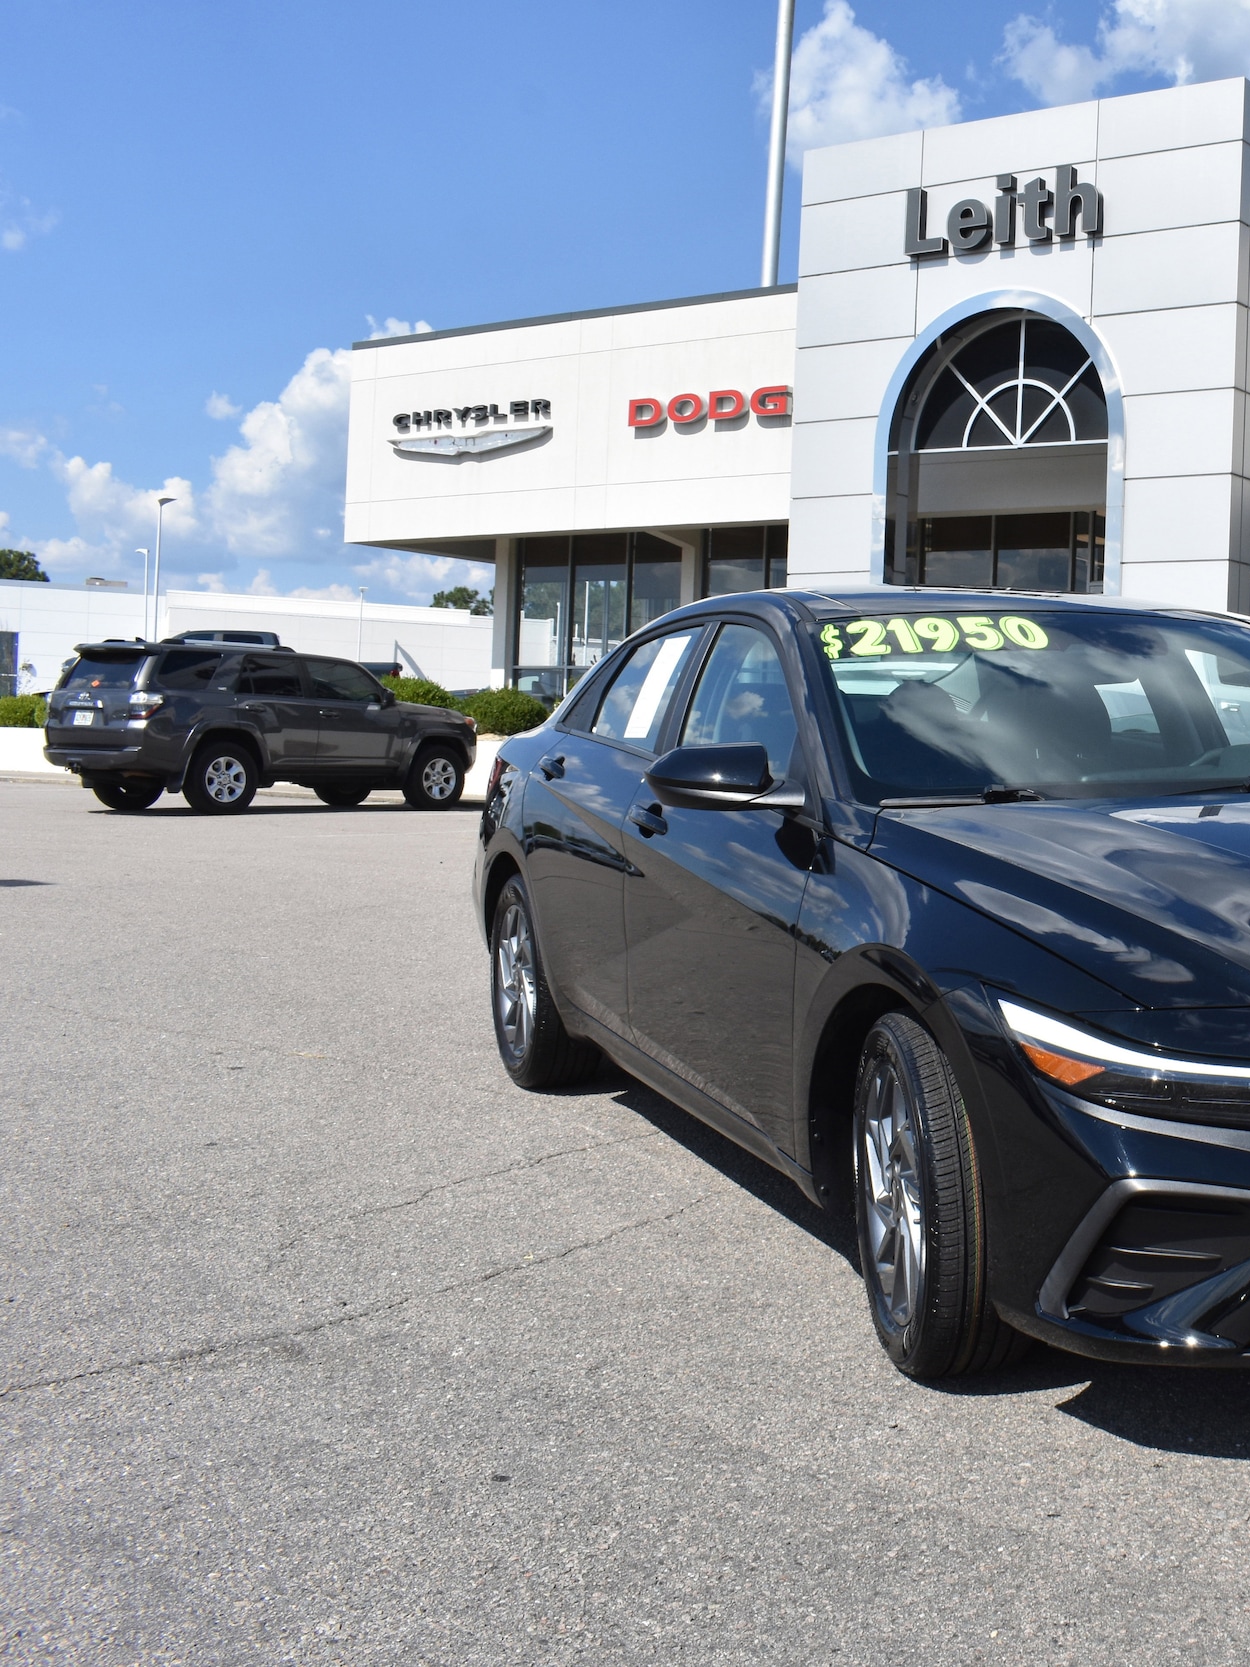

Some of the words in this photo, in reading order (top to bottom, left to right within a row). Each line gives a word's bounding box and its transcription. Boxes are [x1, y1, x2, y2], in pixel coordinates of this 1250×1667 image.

[904, 165, 1103, 257] Leith
[392, 398, 551, 430] CHRYSLER
[628, 385, 792, 427] DODG
[820, 616, 1049, 659] $21950
